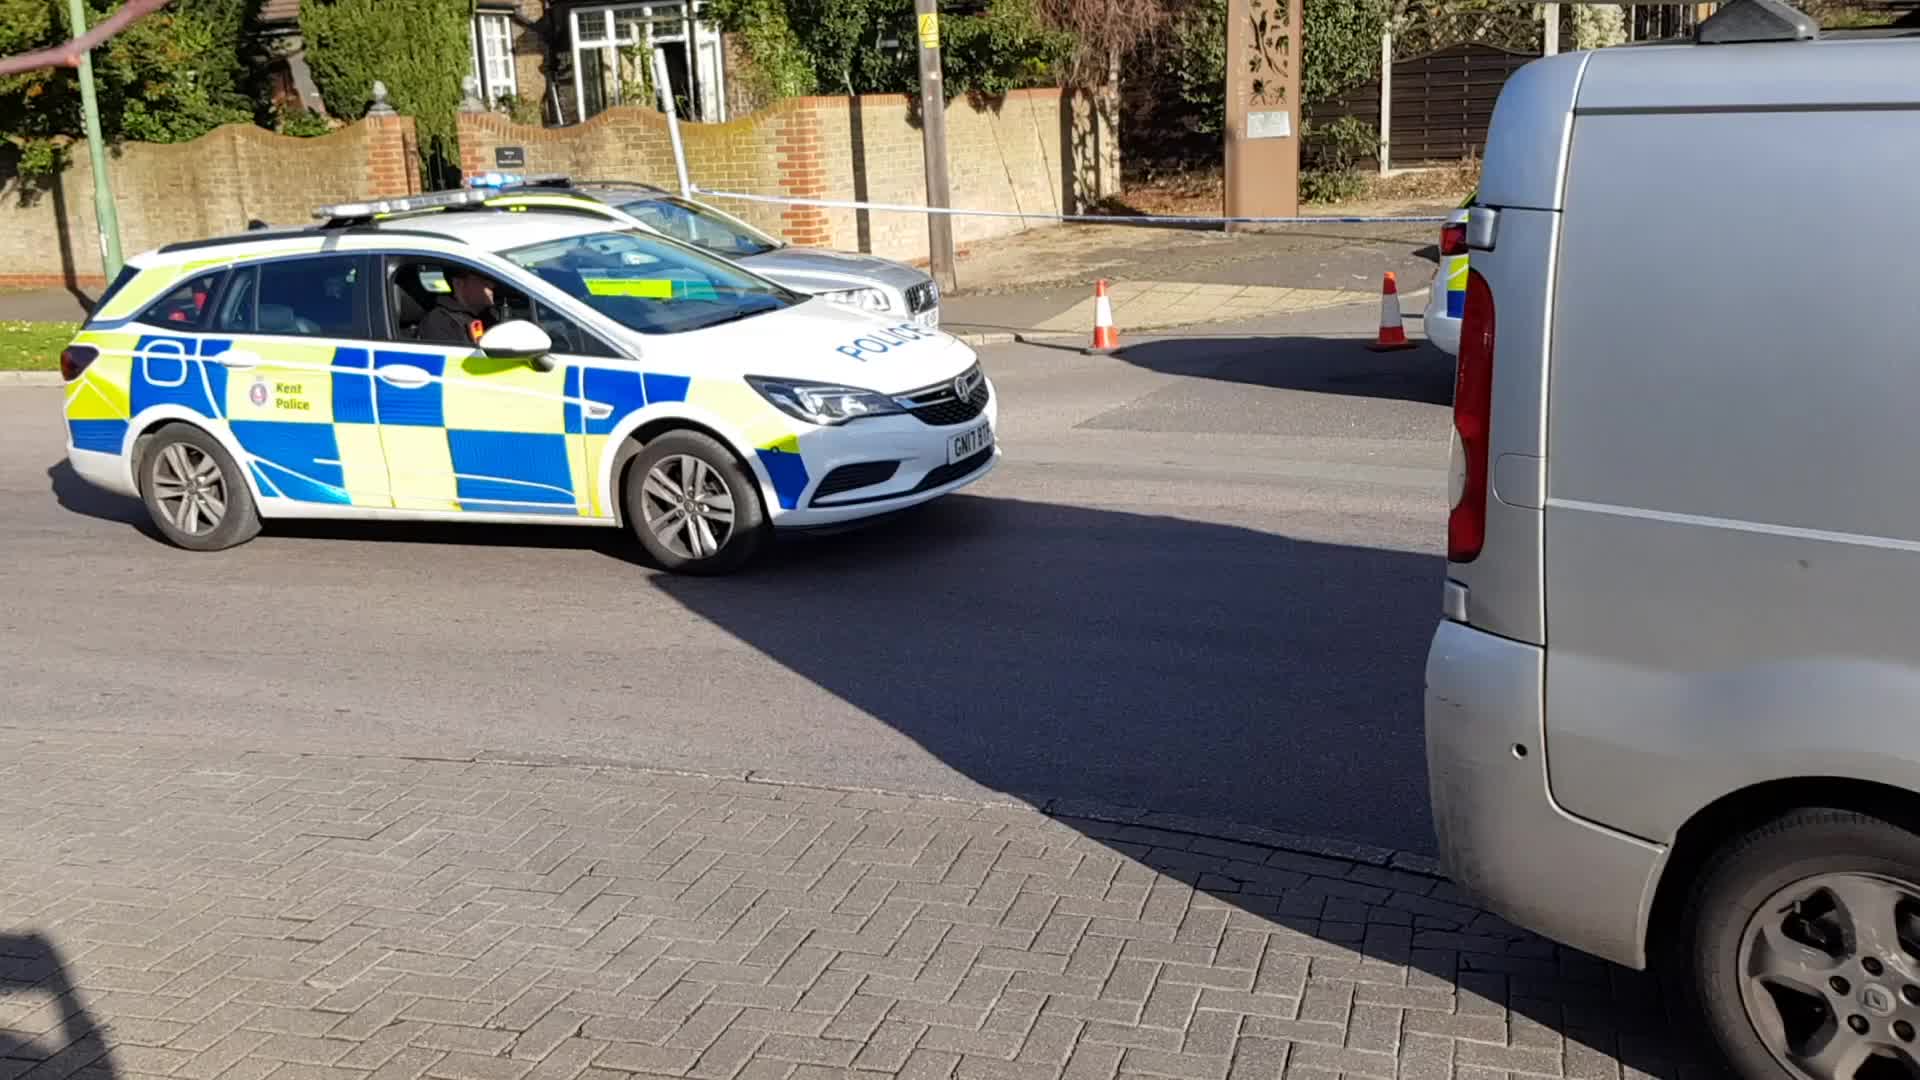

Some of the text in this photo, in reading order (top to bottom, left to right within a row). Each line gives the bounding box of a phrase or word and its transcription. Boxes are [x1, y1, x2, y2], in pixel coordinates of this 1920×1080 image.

[836, 323, 936, 362] POLICE
[275, 383, 303, 393] Kent
[275, 398, 310, 411] Police
[954, 432, 976, 457] GN17
